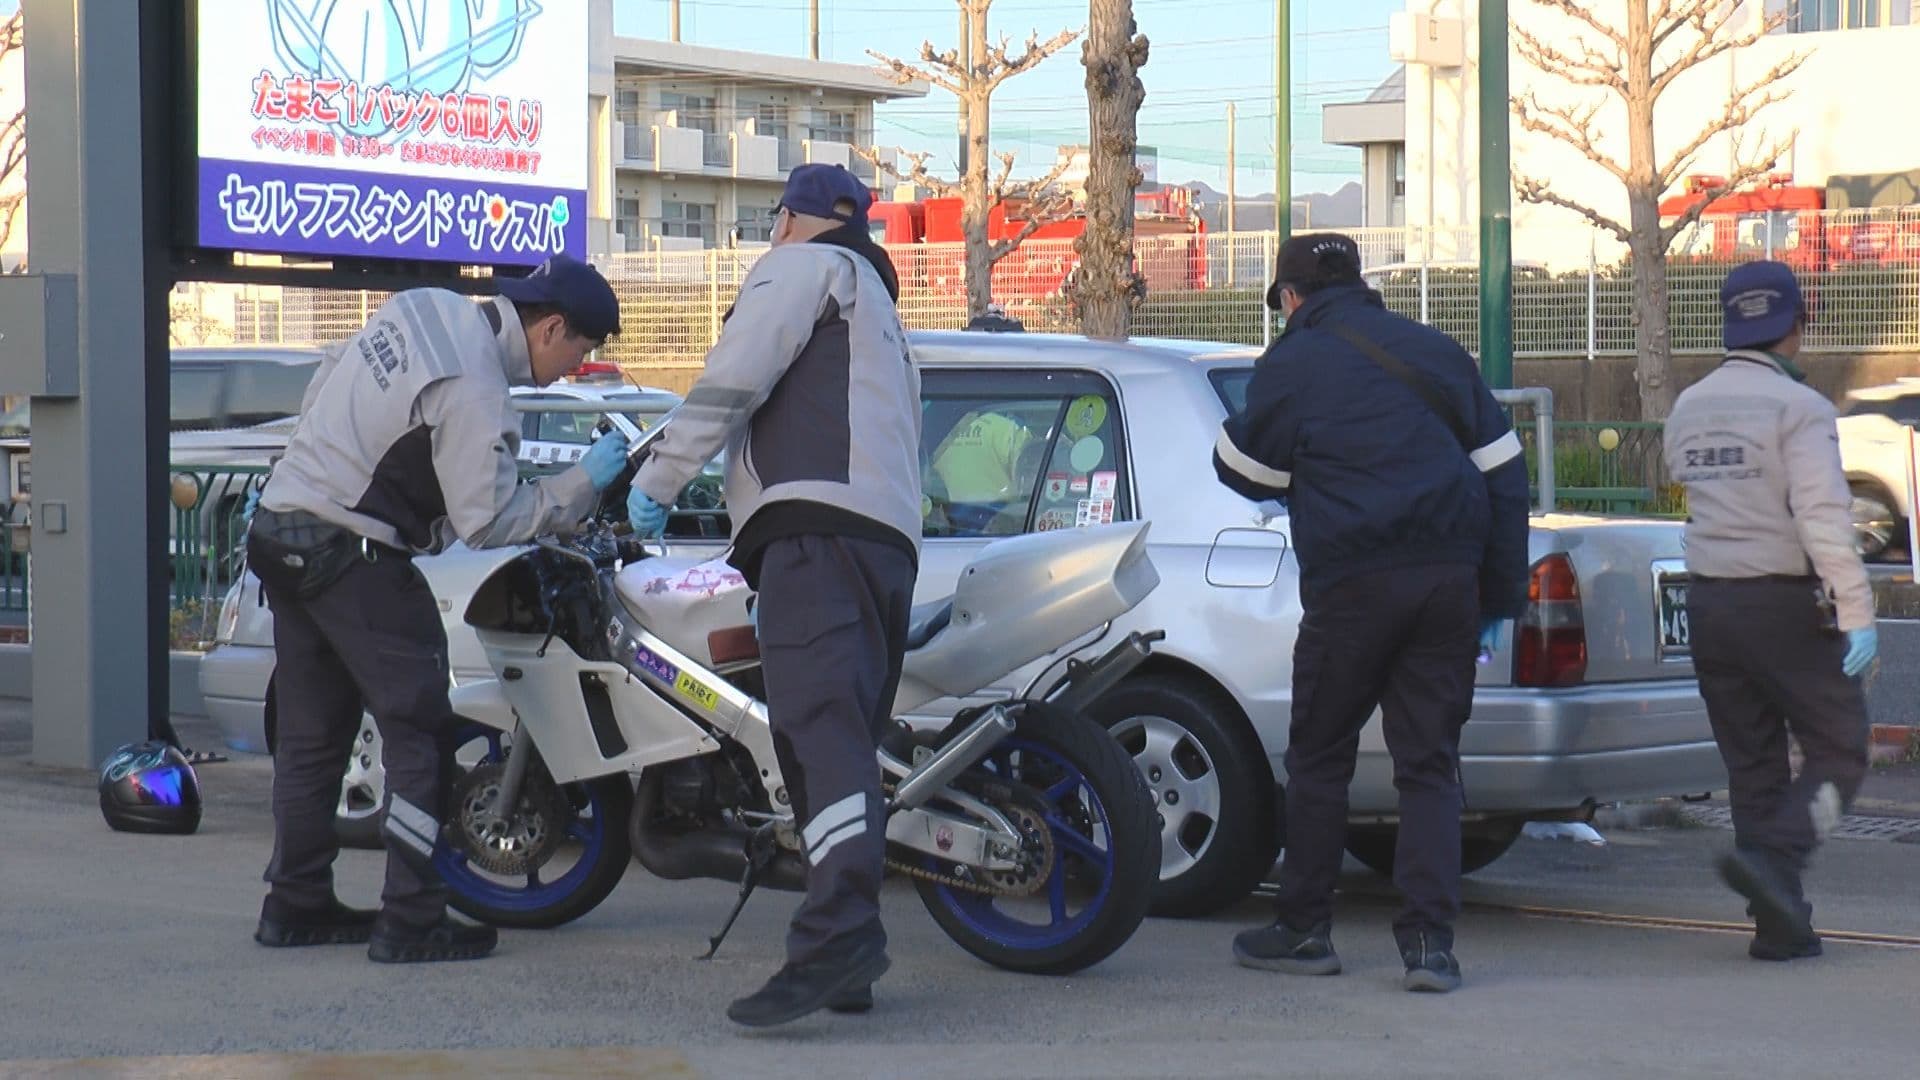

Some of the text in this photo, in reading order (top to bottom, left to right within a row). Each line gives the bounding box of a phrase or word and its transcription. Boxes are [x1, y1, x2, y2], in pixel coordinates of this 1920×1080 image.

[252, 71, 542, 145] たまご1パック6個入り
[219, 173, 570, 252] セルフスタンド サンスパ
